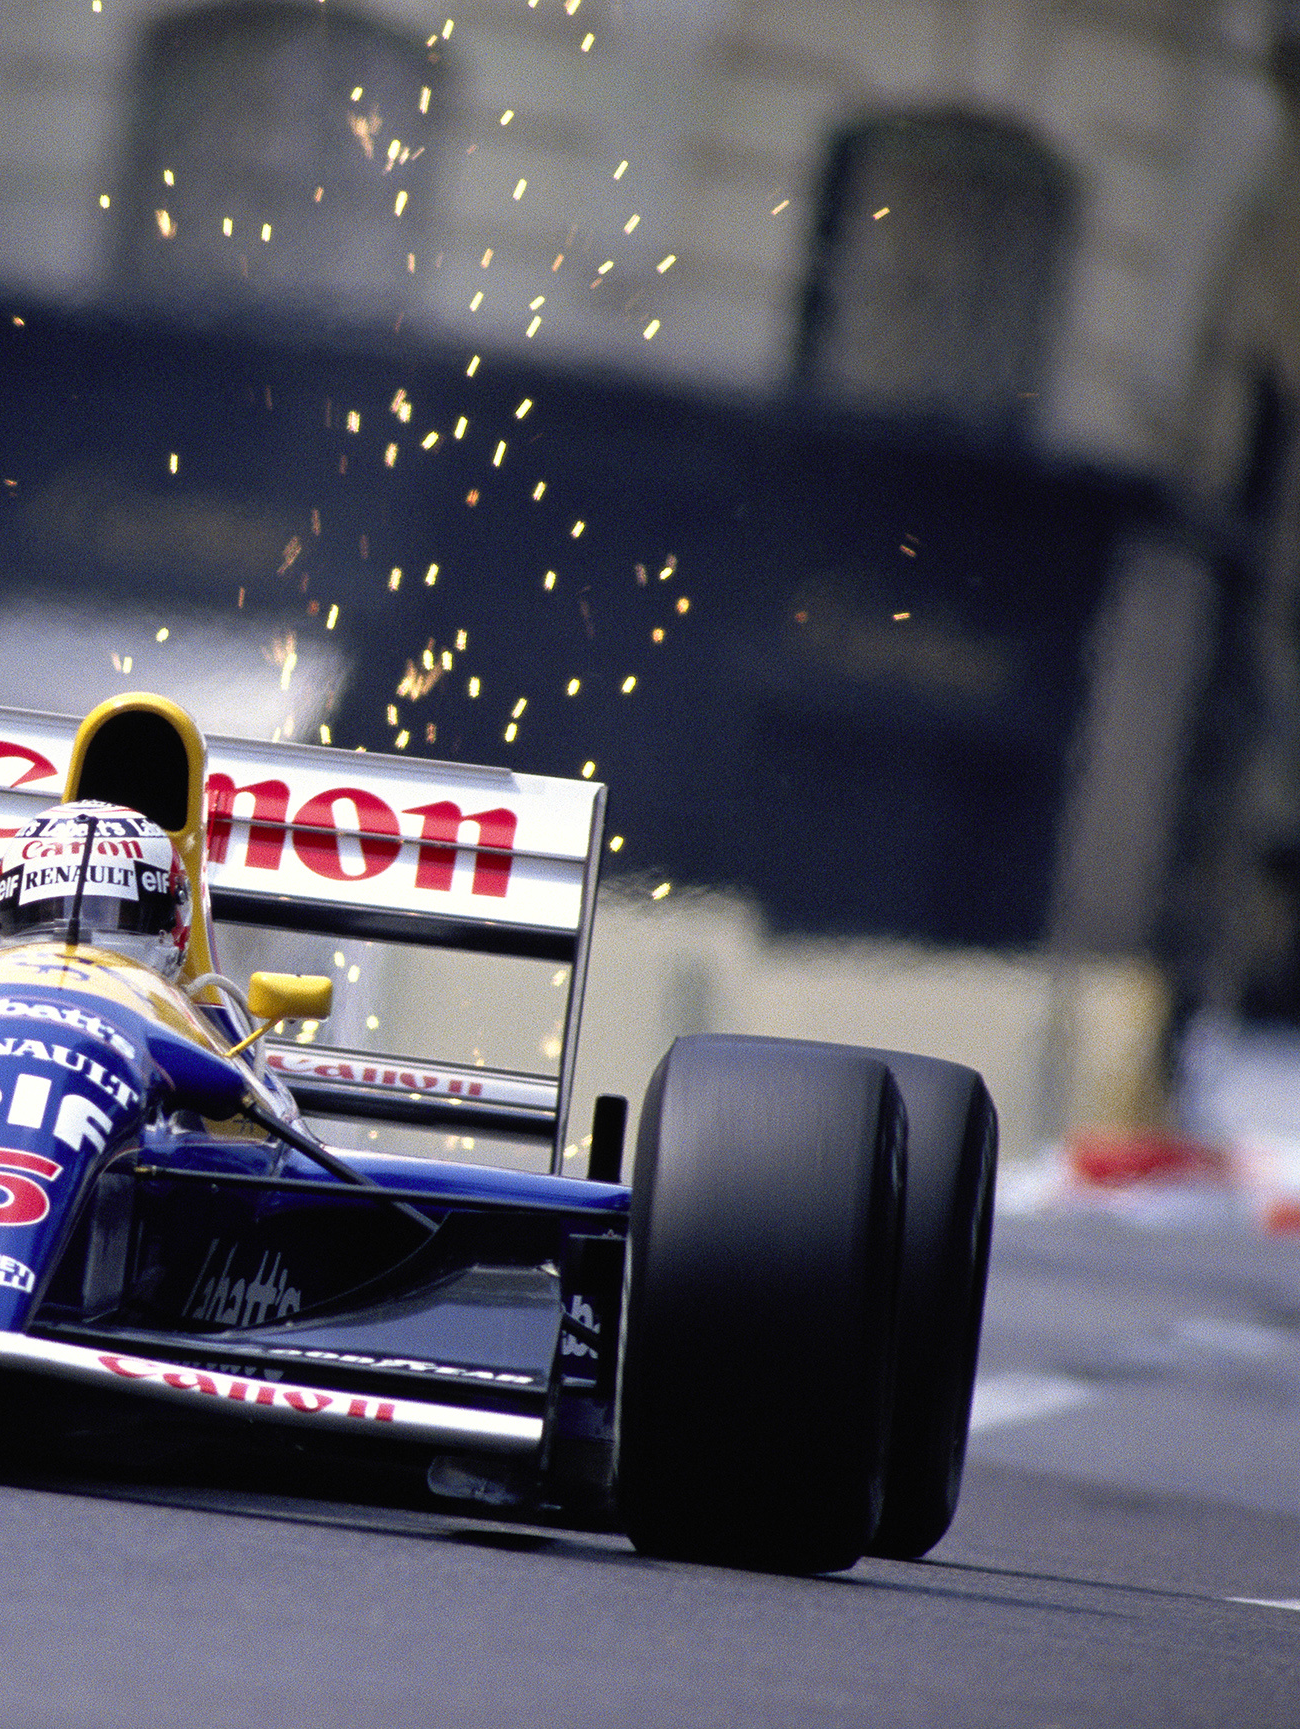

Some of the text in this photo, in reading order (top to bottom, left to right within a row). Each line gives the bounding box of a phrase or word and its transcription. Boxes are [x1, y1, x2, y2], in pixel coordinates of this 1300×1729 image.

[22, 840, 144, 860] Canon
[24, 865, 134, 891] RENAULT
[141, 871, 170, 894] elf
[266, 1055, 483, 1097] Canon
[98, 1355, 396, 1423] Canon
